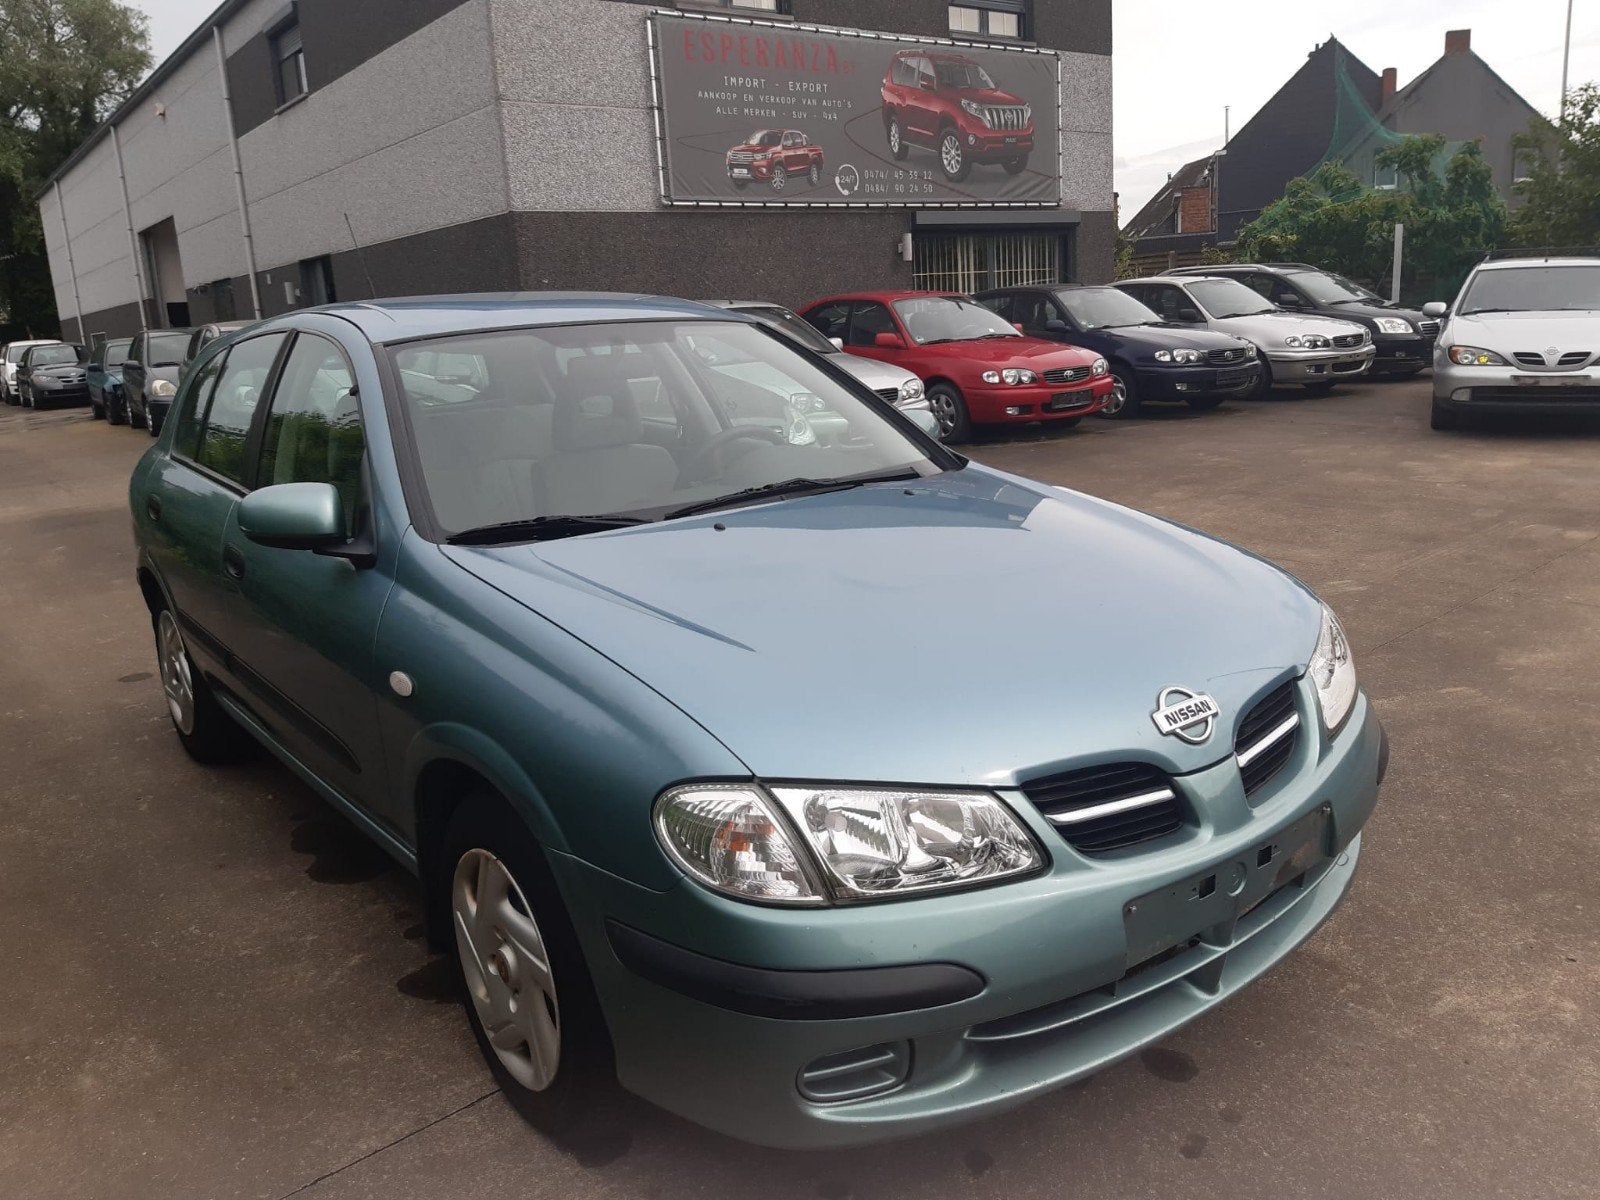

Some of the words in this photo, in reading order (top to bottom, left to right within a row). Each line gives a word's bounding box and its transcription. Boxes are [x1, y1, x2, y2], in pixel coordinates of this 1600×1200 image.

[683, 30, 839, 75] ESPERANZA
[724, 76, 766, 89] IMPORT
[789, 81, 828, 93] EXPORT
[698, 90, 737, 100] AANKOOP
[743, 94, 754, 102] EN
[759, 95, 797, 105] VERKOOP
[802, 98, 817, 106] VAN
[822, 99, 852, 109] AUTO'S
[716, 106, 738, 115] ALLE
[744, 108, 776, 118] MERKEN
[792, 110, 808, 119] SUV
[841, 174, 855, 184] 24/7
[864, 170, 889, 180] 0474/
[894, 170, 904, 180] 45
[923, 170, 933, 180] 12
[864, 183, 889, 193] 0484/
[894, 183, 905, 193] 90
[909, 183, 919, 193] 24
[923, 183, 933, 193] 50
[1164, 700, 1212, 726] NISSAN
